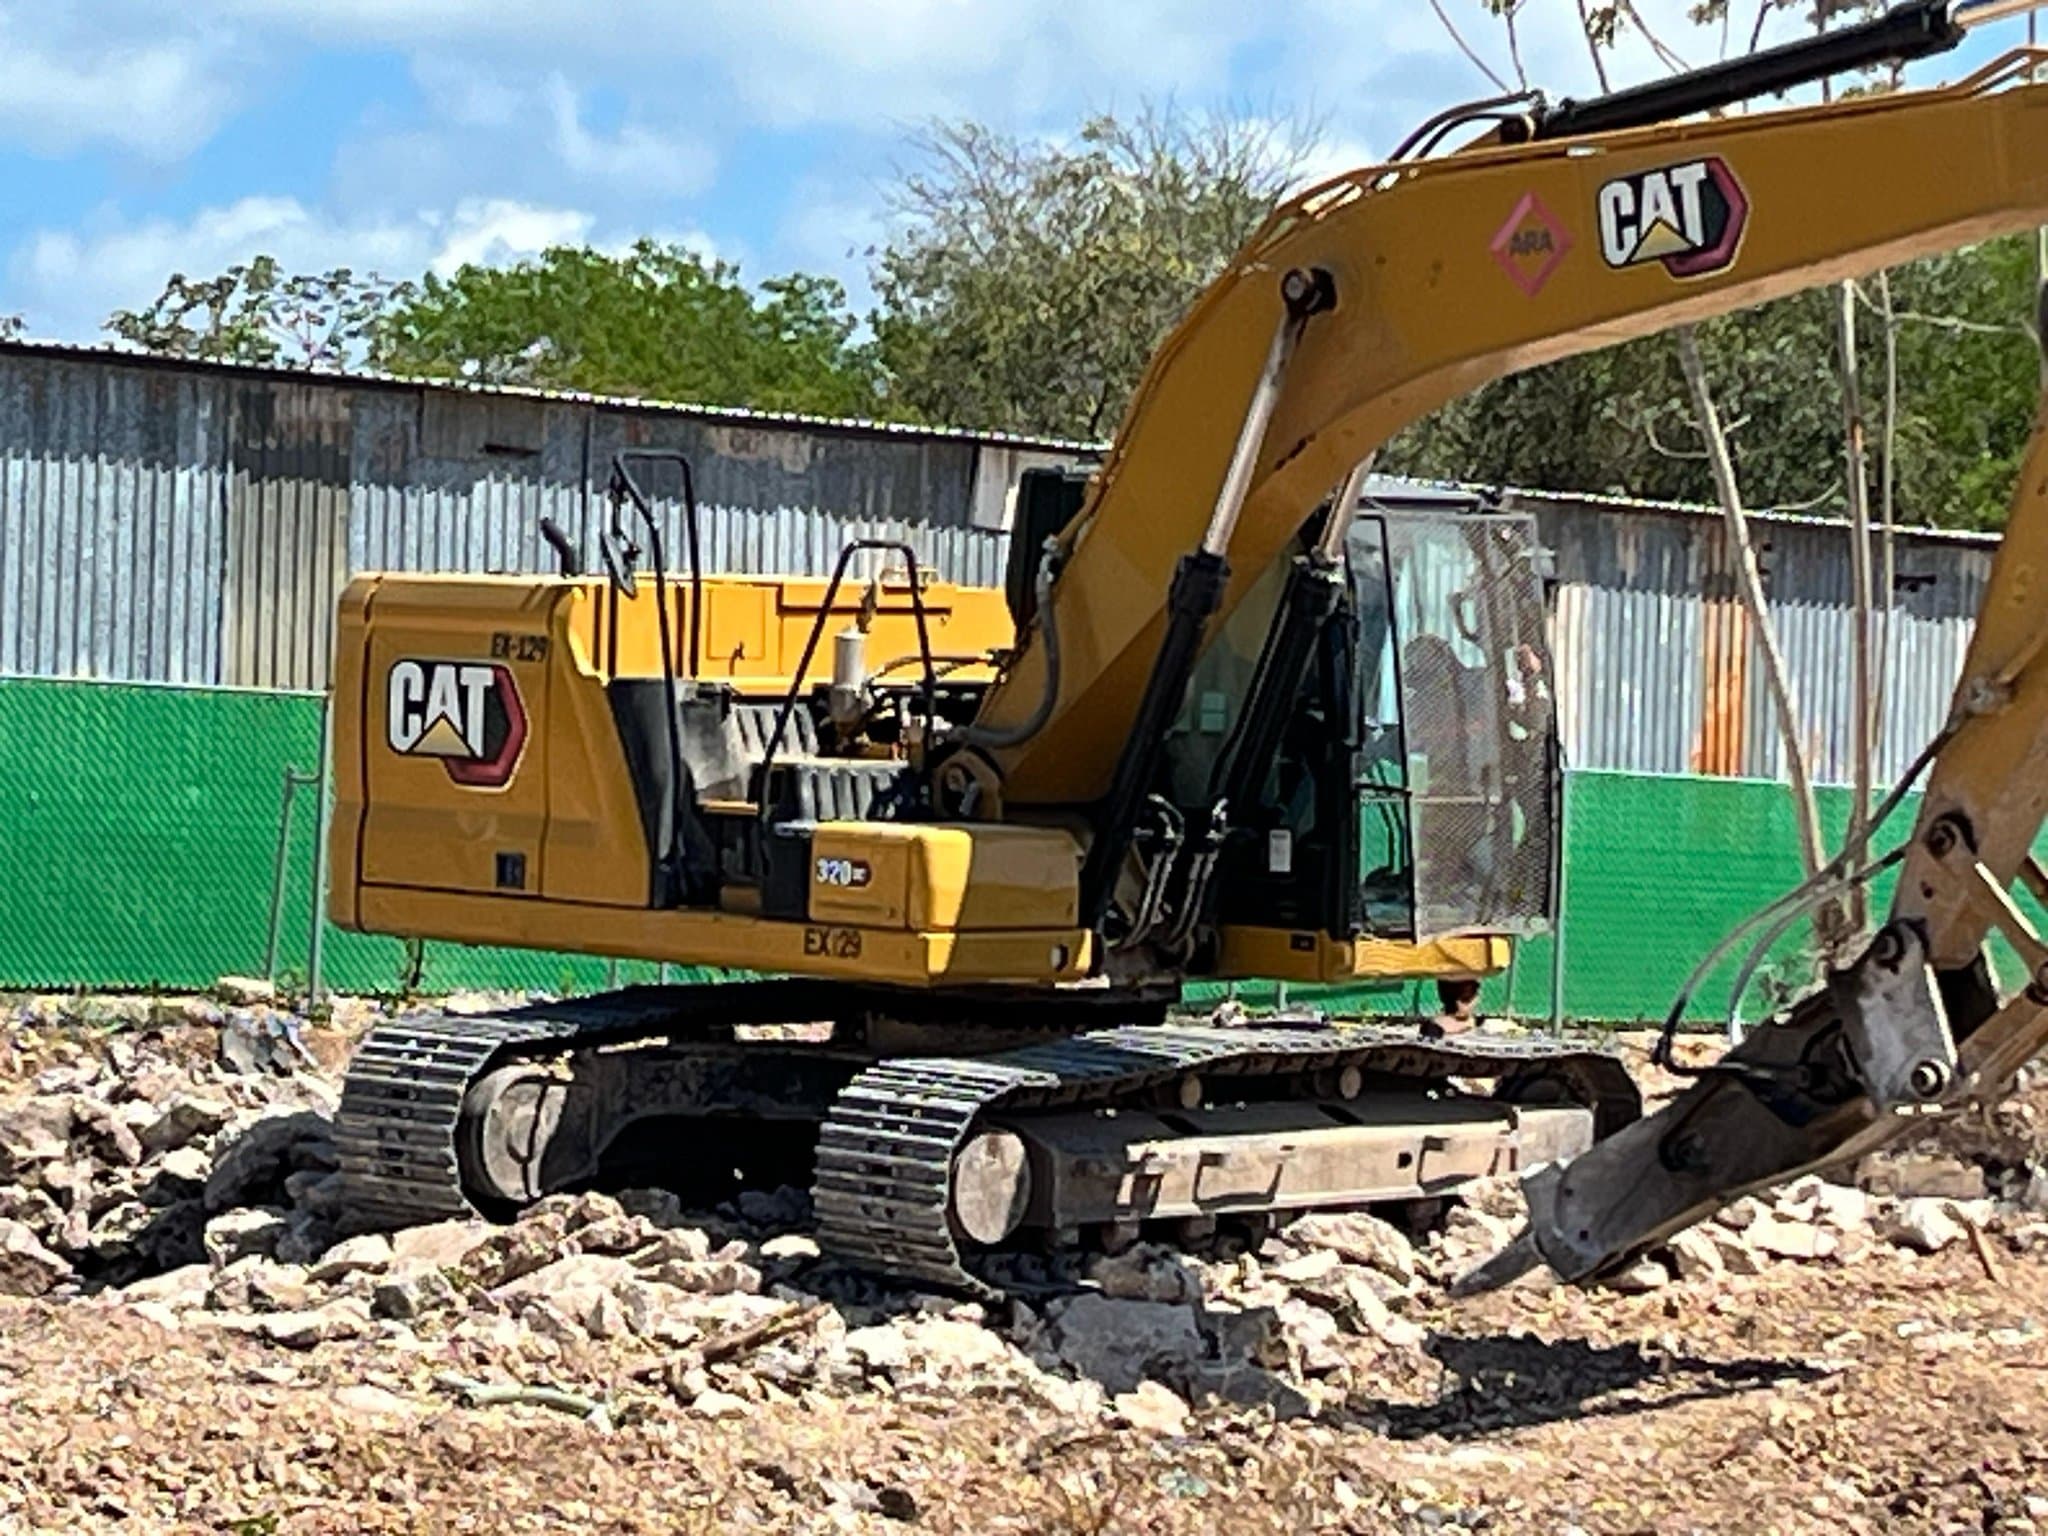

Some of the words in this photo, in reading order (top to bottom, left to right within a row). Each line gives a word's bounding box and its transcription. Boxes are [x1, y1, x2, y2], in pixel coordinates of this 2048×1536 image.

[1600, 162, 1707, 266] CAT
[389, 661, 494, 758] CAT
[816, 858, 852, 885] 320
